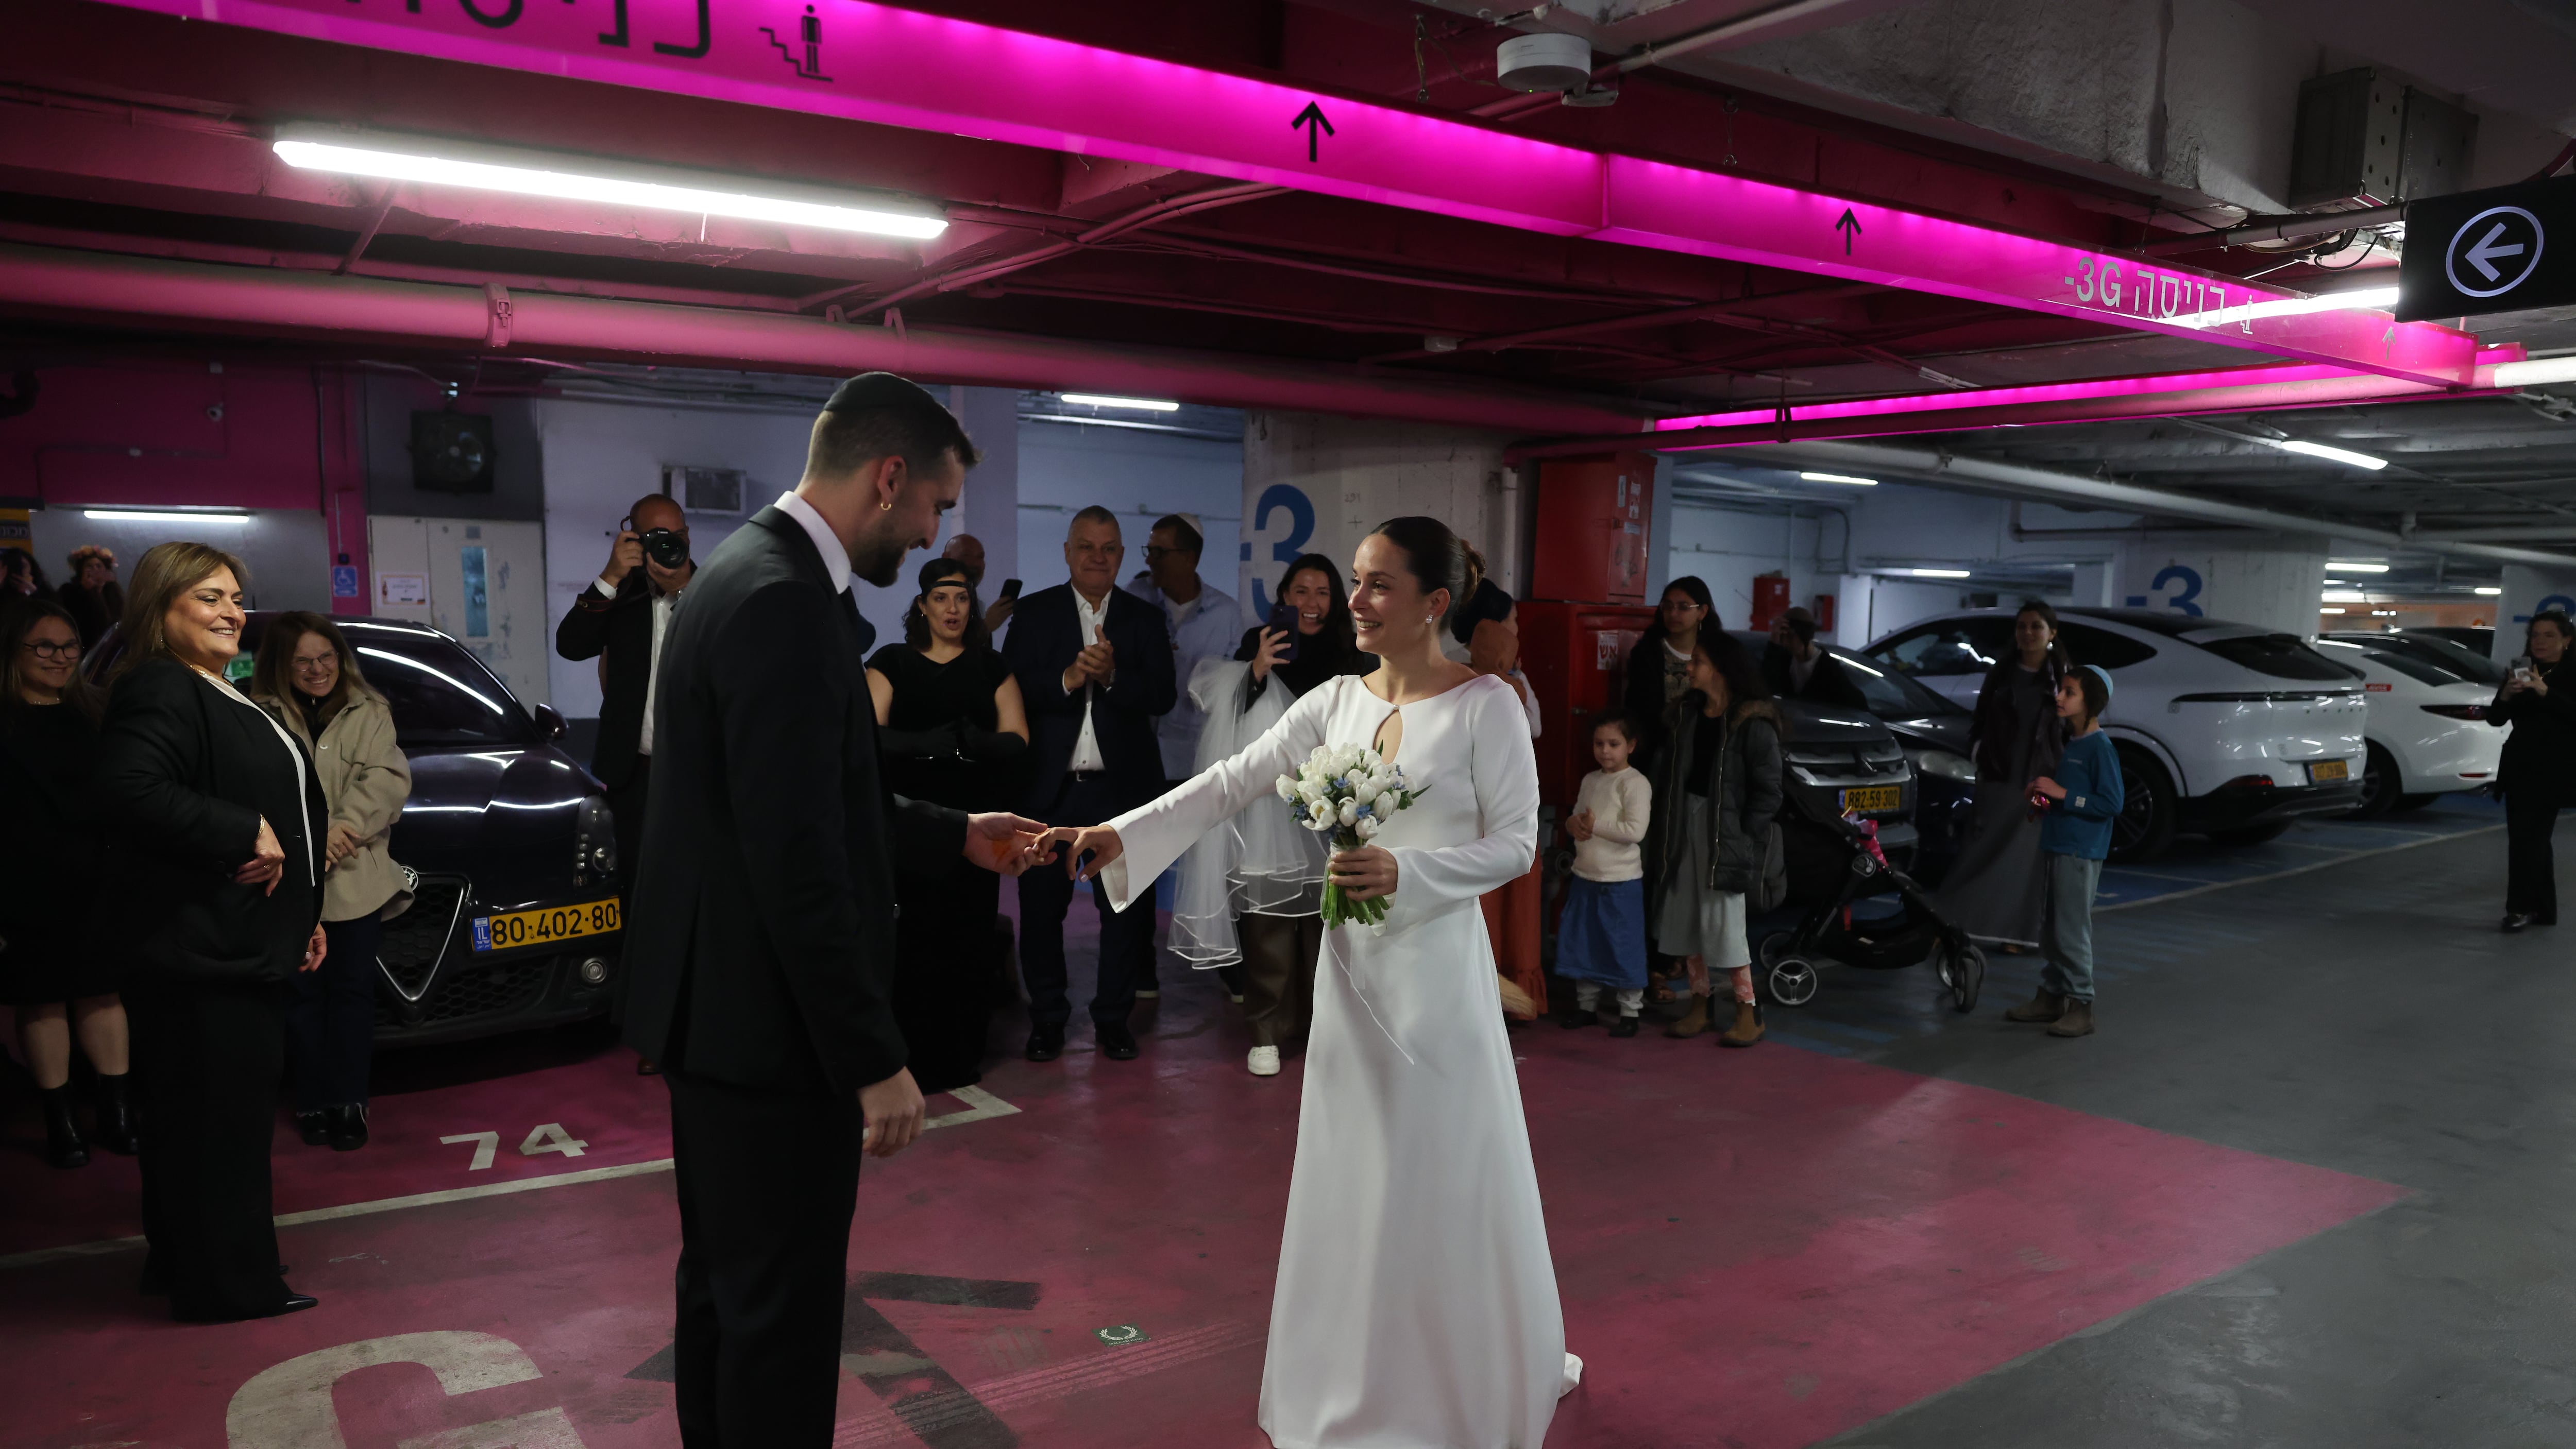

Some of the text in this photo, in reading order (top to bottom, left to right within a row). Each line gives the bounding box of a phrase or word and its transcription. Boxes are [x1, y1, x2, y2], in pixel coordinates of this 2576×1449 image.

[2134, 269, 2225, 327] כניסה
[477, 927, 488, 940] IL
[439, 1123, 589, 1171] 74
